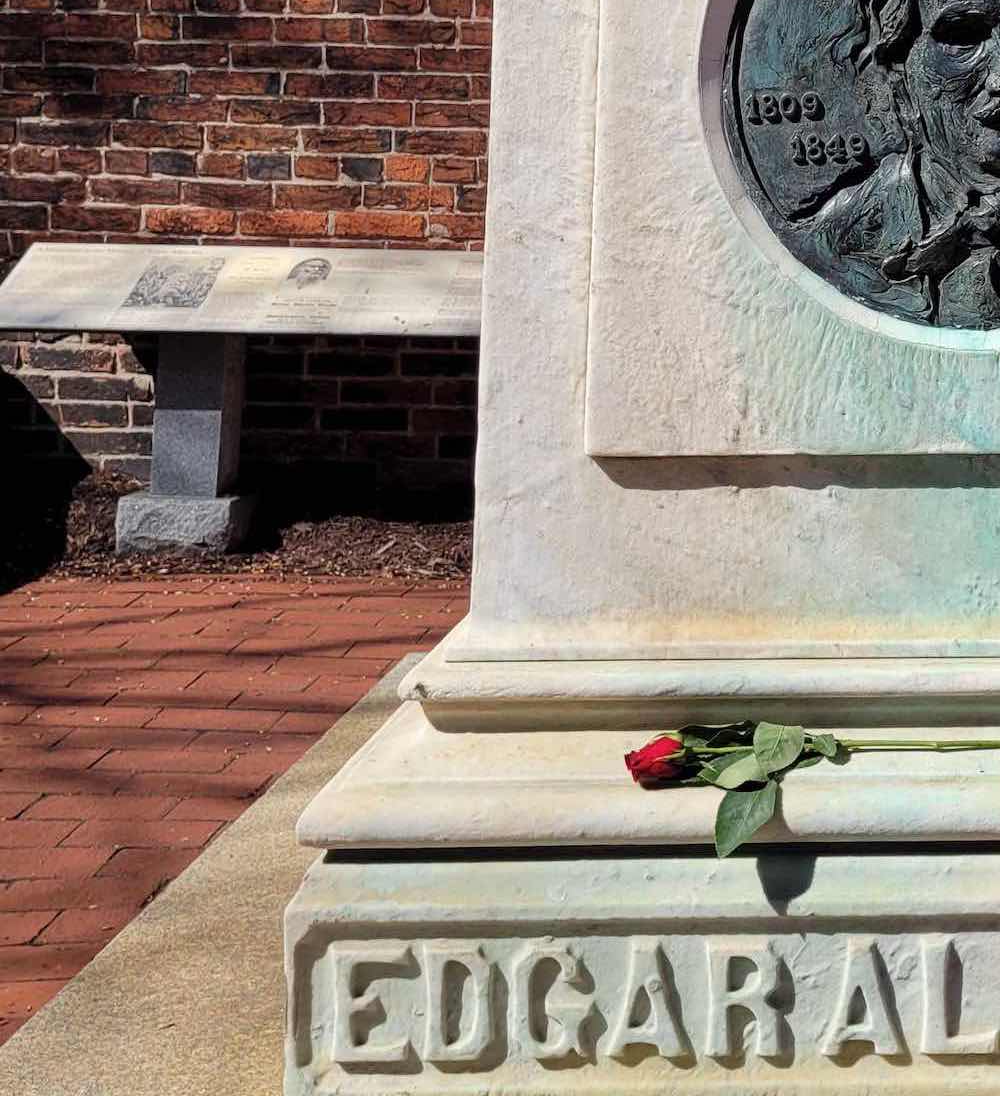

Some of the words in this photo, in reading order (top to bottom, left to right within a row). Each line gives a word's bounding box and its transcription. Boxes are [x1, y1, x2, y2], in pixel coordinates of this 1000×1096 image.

[745, 92, 825, 125] 1809
[791, 131, 870, 166] 1849
[332, 936, 791, 1069] EDGAR
